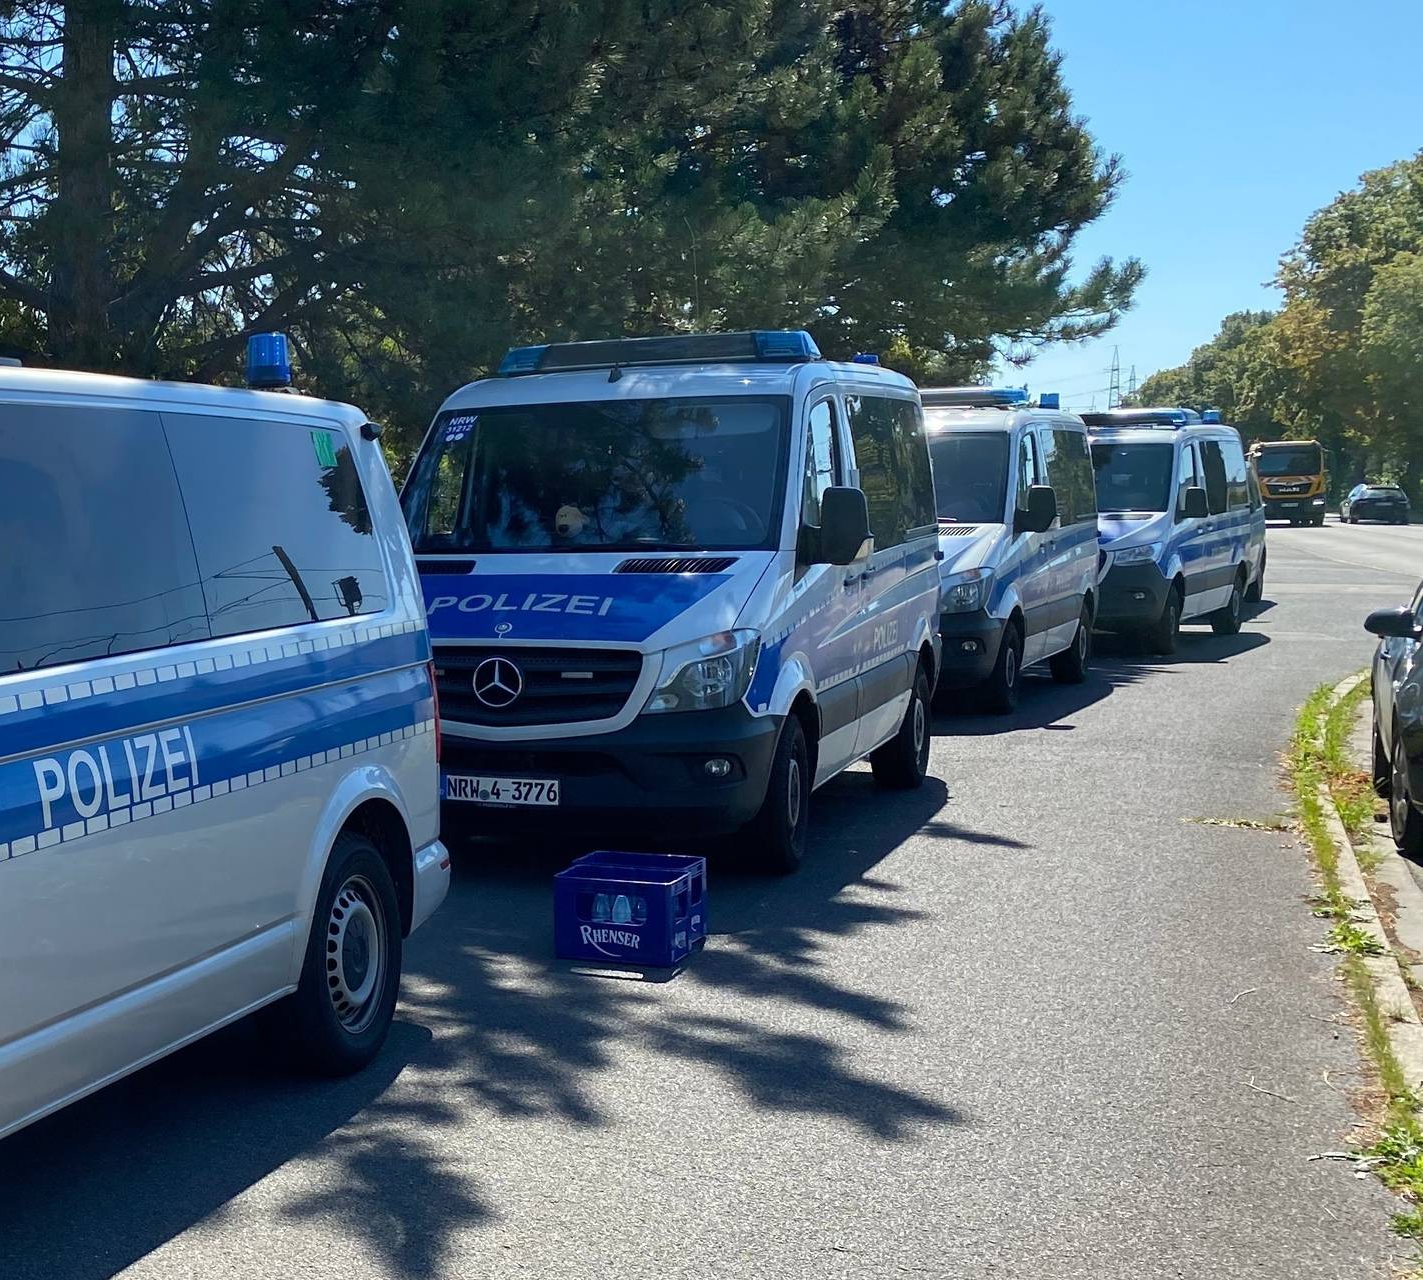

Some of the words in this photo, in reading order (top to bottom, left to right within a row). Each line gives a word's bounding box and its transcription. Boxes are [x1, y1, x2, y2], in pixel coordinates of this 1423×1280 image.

[449, 415, 478, 425] NRW
[427, 594, 614, 616] POLIZEI
[873, 620, 897, 653] POLIZEI
[33, 726, 199, 829] POLIZEI
[447, 778, 480, 798] NRW
[491, 781, 557, 802] 4-3776
